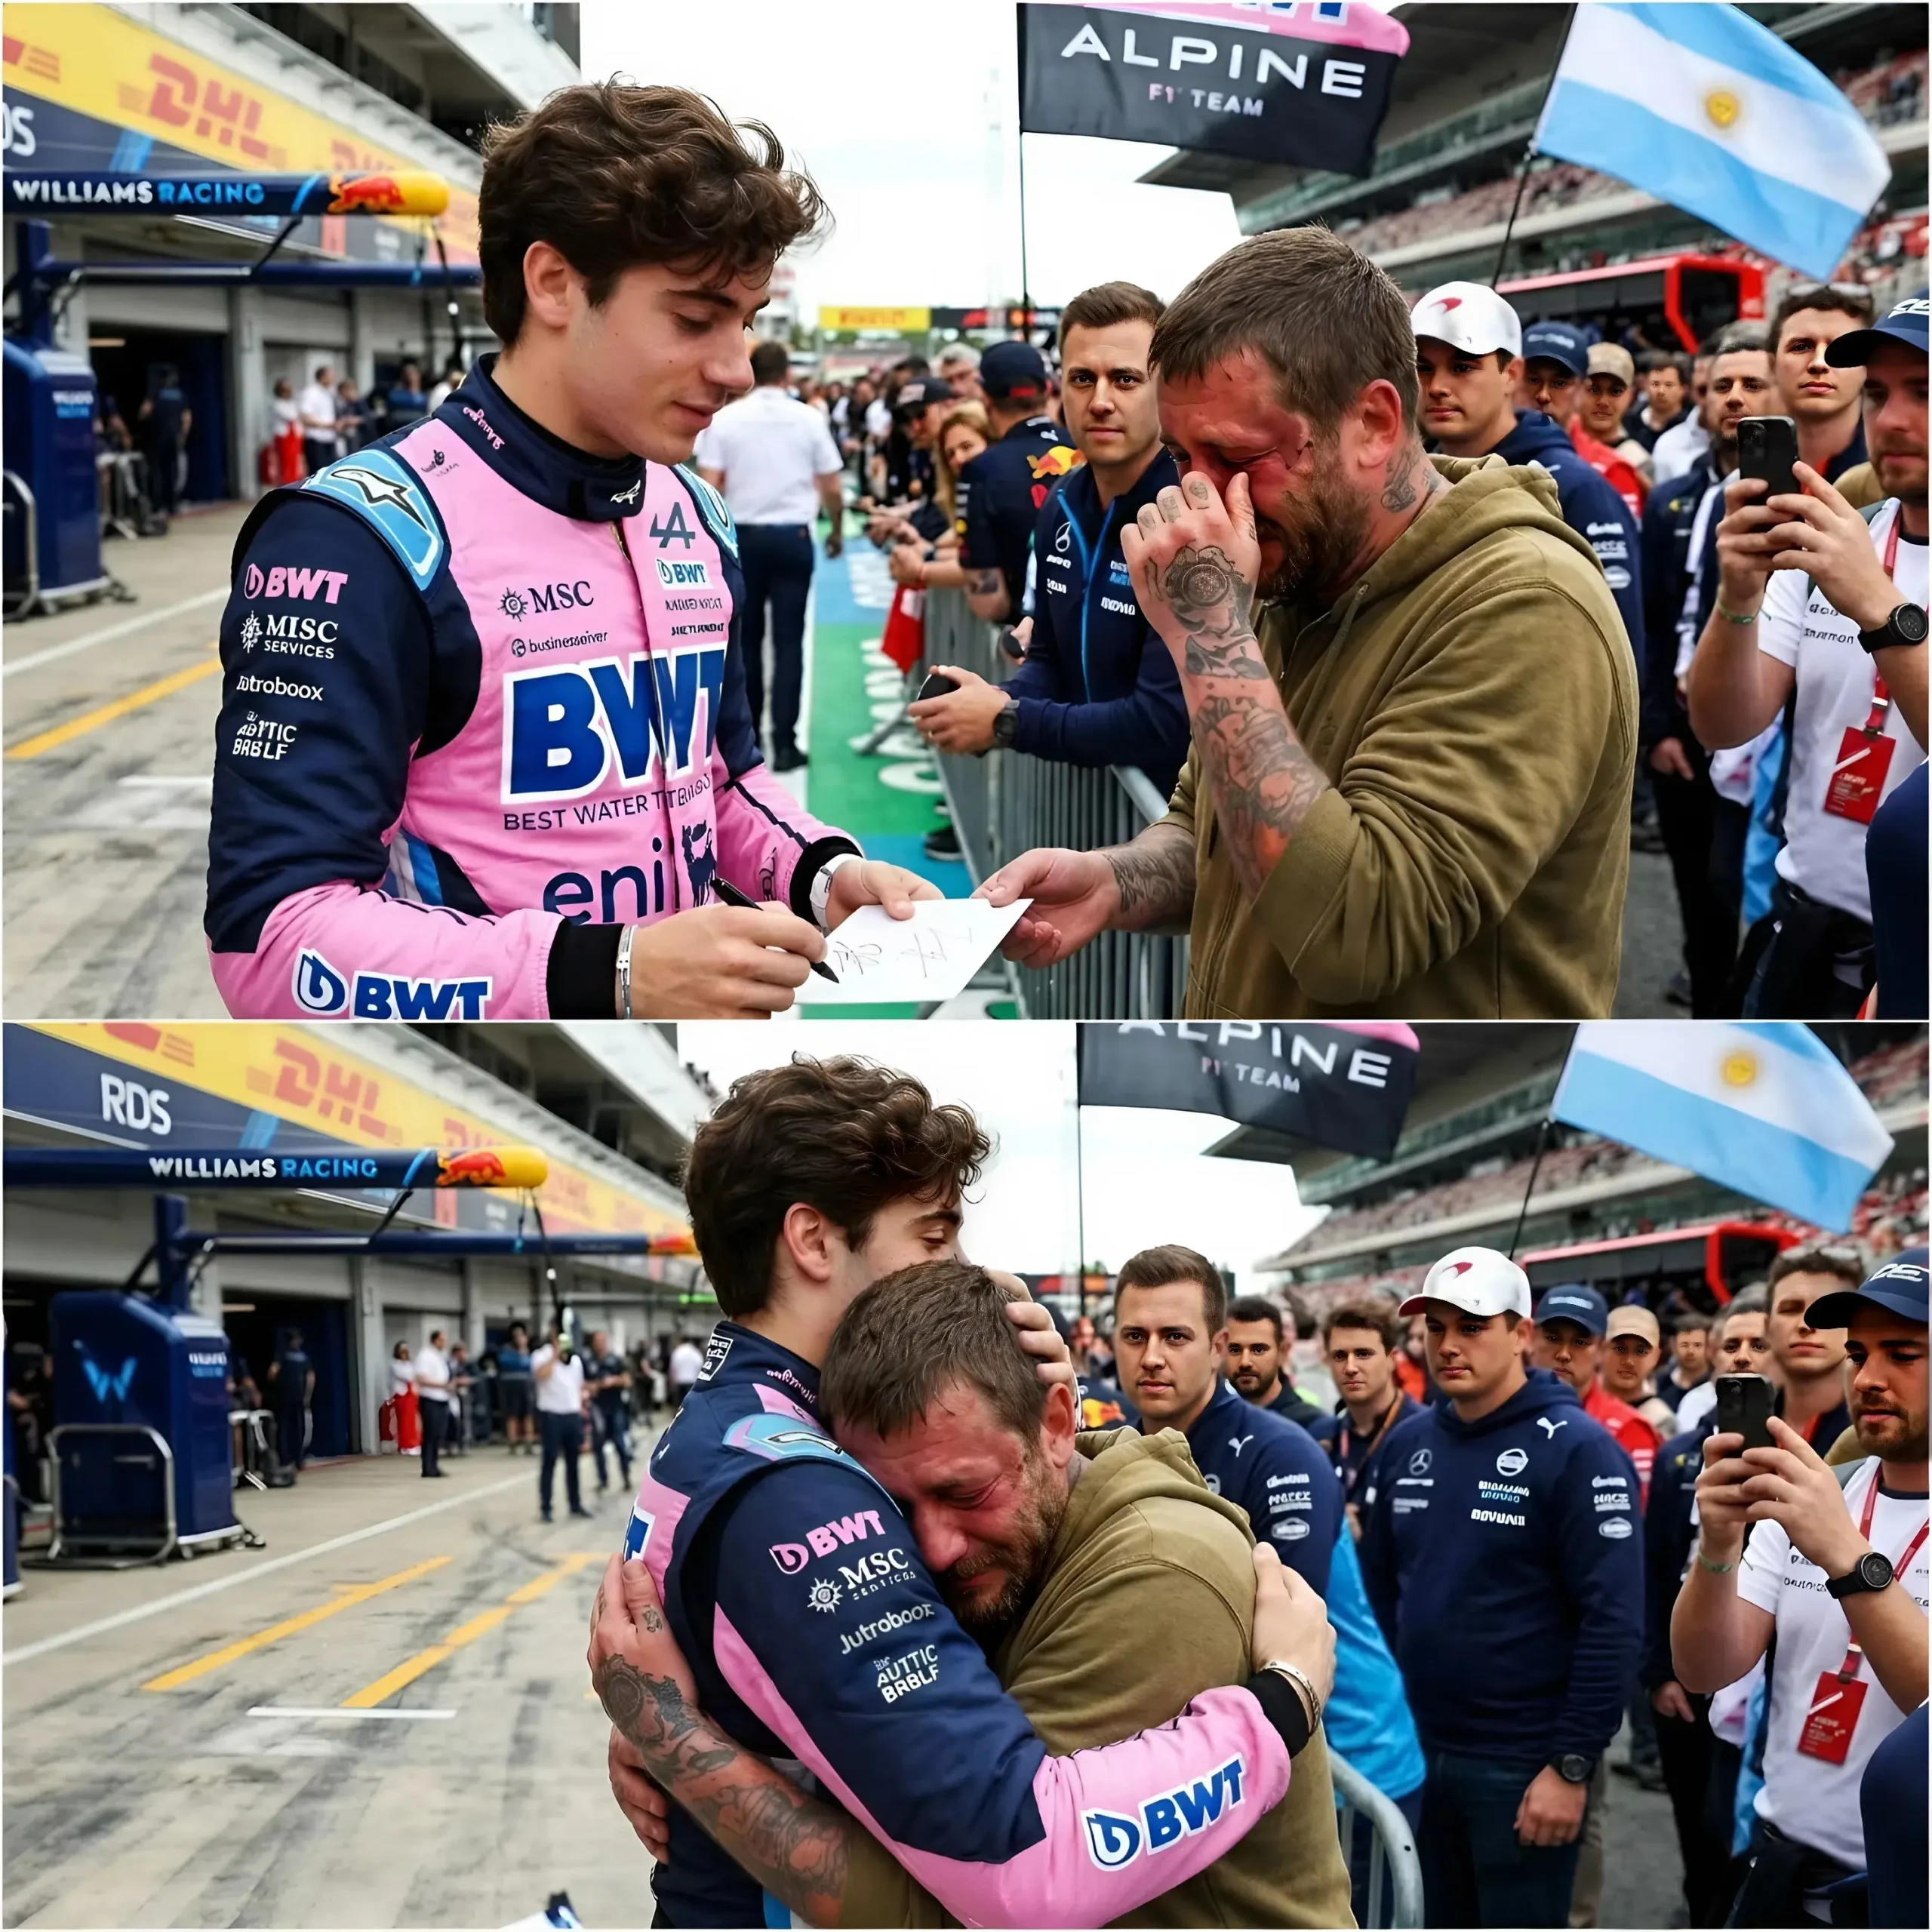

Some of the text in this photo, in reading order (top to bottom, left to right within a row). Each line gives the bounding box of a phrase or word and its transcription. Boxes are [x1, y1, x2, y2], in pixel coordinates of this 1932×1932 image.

[1061, 23, 1365, 97] ALPINE
[149, 53, 268, 159] DHL
[1190, 88, 1263, 116] TEAM
[13, 180, 264, 204] WILLIAMS RACING
[265, 567, 348, 604] BWT
[528, 581, 594, 614] MSC
[266, 614, 338, 643] MISC
[264, 640, 334, 659] SERVICES
[509, 648, 725, 795] BWT
[504, 810, 566, 829] BEST
[574, 794, 648, 824] WATER
[543, 837, 664, 924] eni
[355, 976, 487, 1019] BWT
[273, 1037, 386, 1139] DHL
[1235, 1063, 1300, 1094] TEAM
[101, 1072, 171, 1135] RDS
[149, 1158, 377, 1177] WILLIAMS RACING
[806, 1510, 886, 1558] BWT
[838, 1549, 909, 1589] MSC
[877, 1644, 938, 1687] AUTTIC
[1144, 1758, 1243, 1849] BWT
